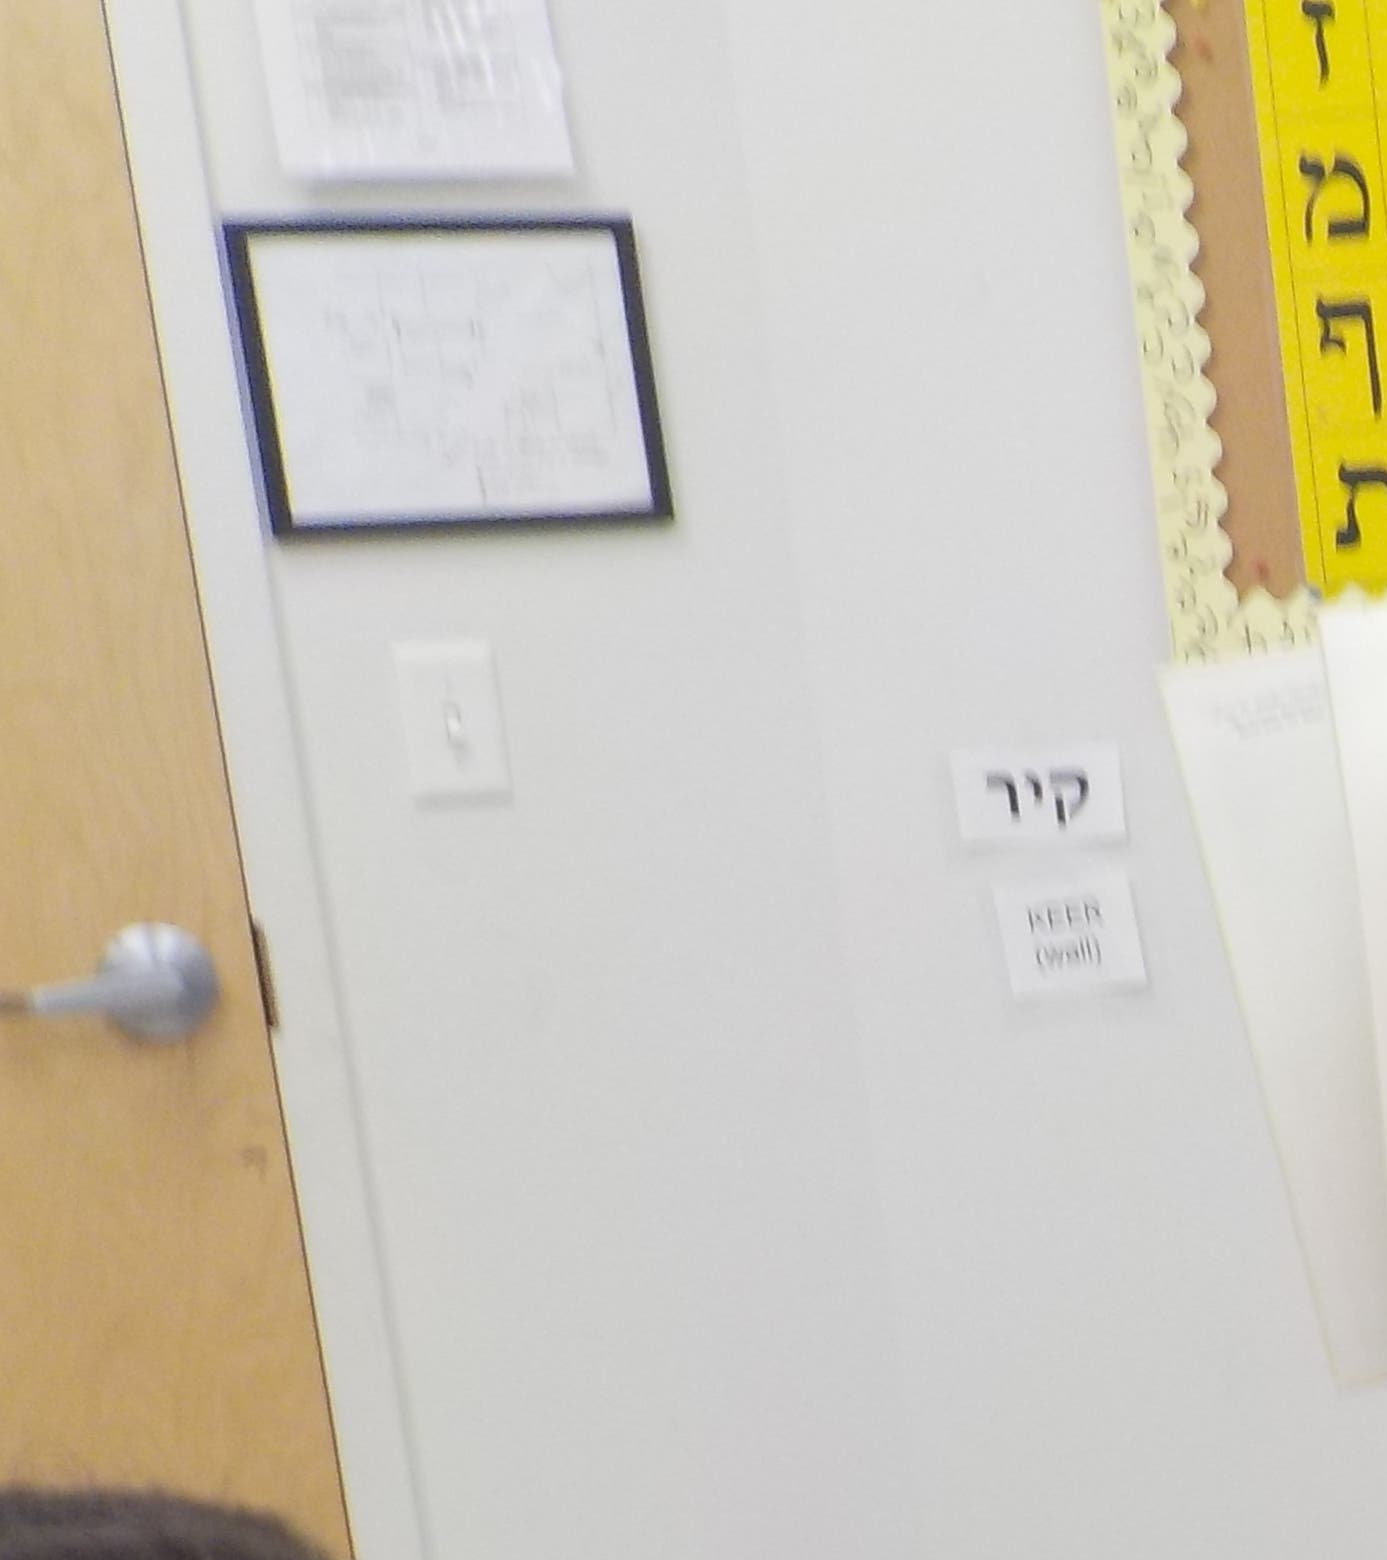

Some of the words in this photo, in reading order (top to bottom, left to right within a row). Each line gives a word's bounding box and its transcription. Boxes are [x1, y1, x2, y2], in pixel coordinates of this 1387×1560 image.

[1302, 1, 1335, 84] ז
[1298, 150, 1373, 246] מ
[1315, 295, 1385, 416] ף
[984, 766, 1092, 832] קיר
[1026, 898, 1104, 935] KEER
